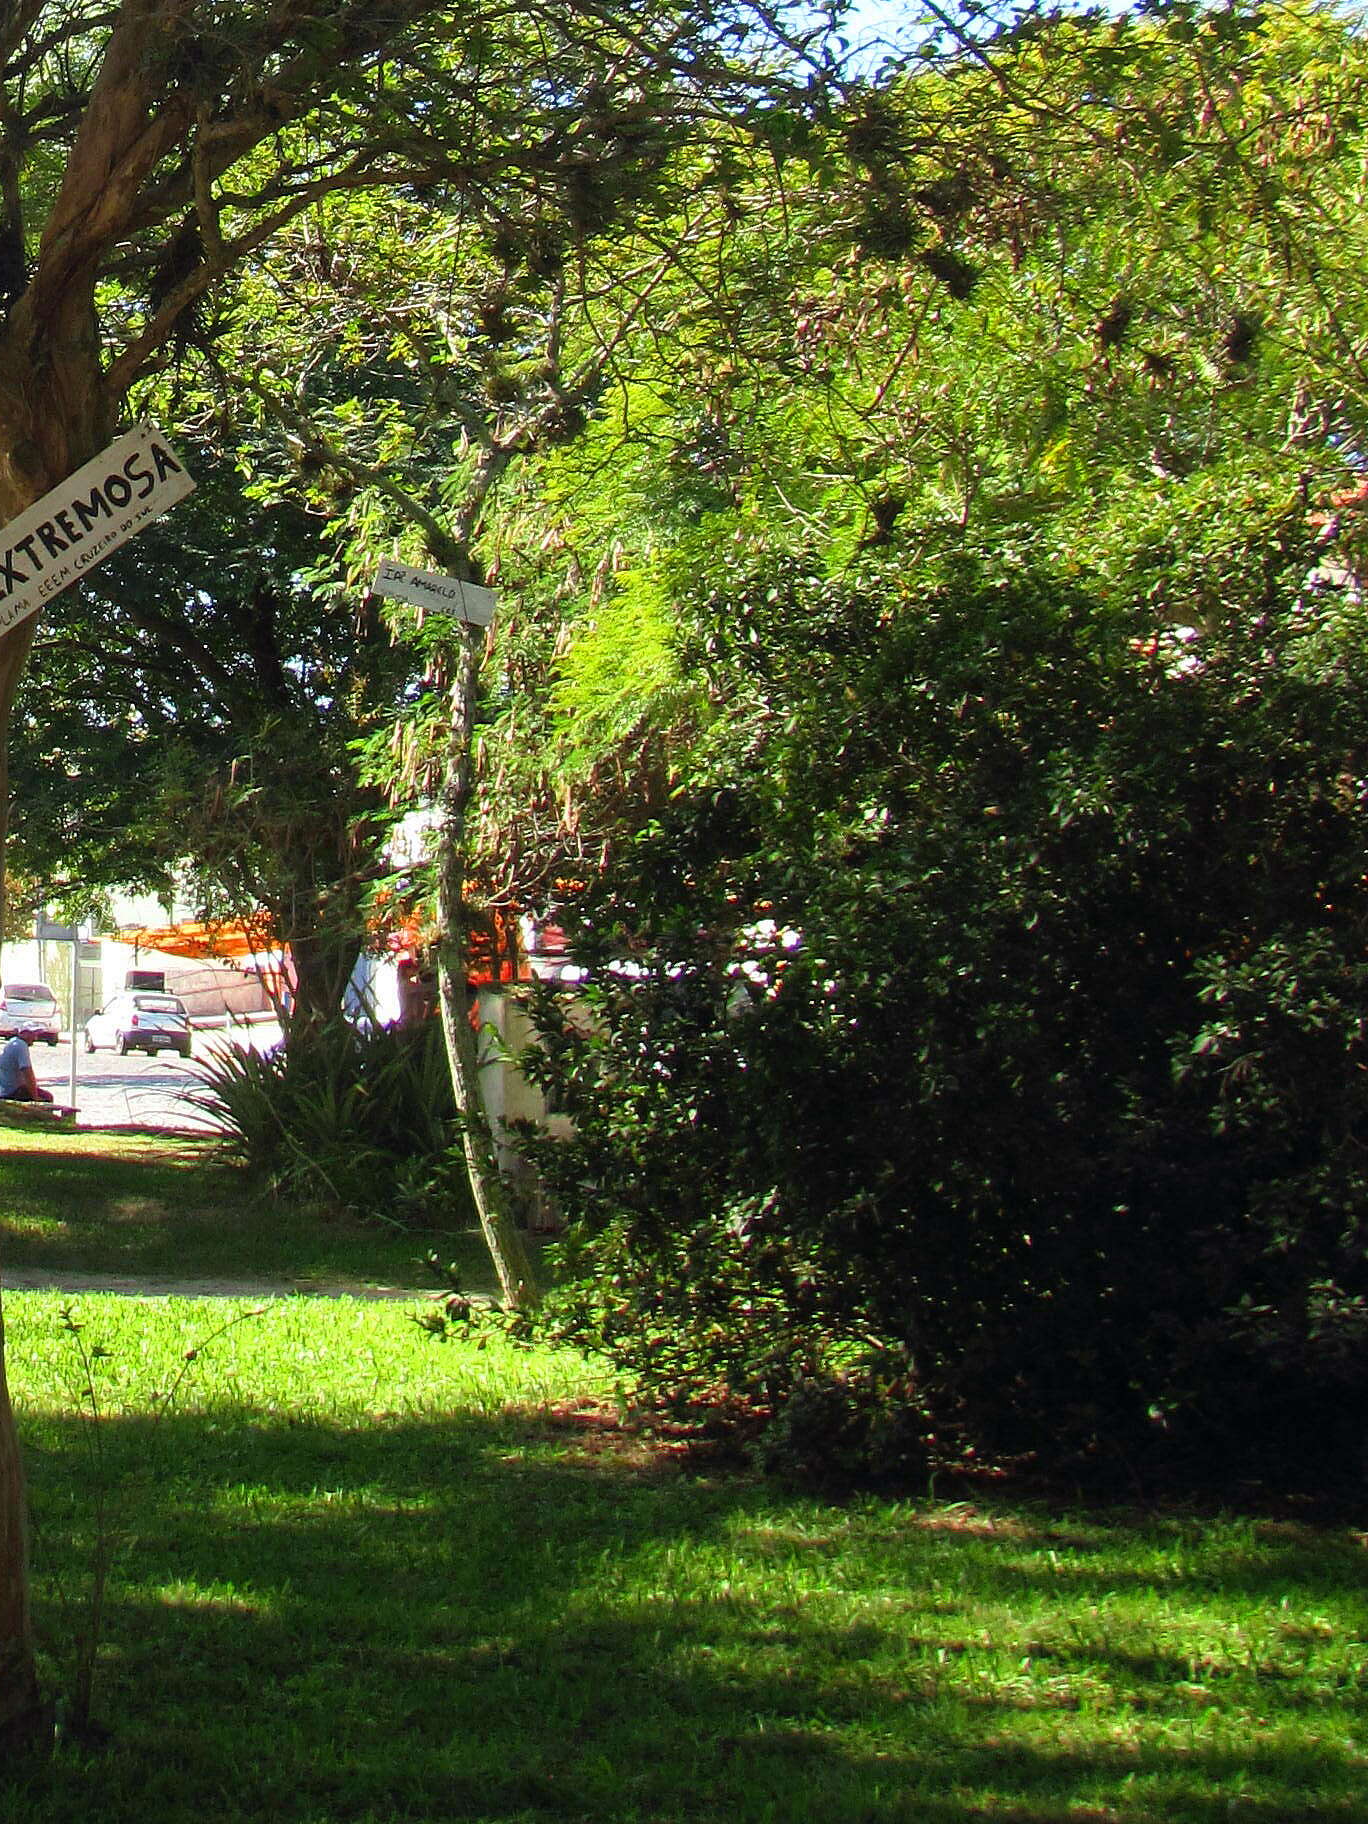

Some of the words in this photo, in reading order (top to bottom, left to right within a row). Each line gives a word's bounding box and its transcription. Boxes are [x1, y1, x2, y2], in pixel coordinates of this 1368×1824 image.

[38, 566, 72, 597] EEEM
[74, 531, 117, 570] CRUZEIRO
[120, 520, 133, 532] DO
[136, 506, 153, 521] SUL
